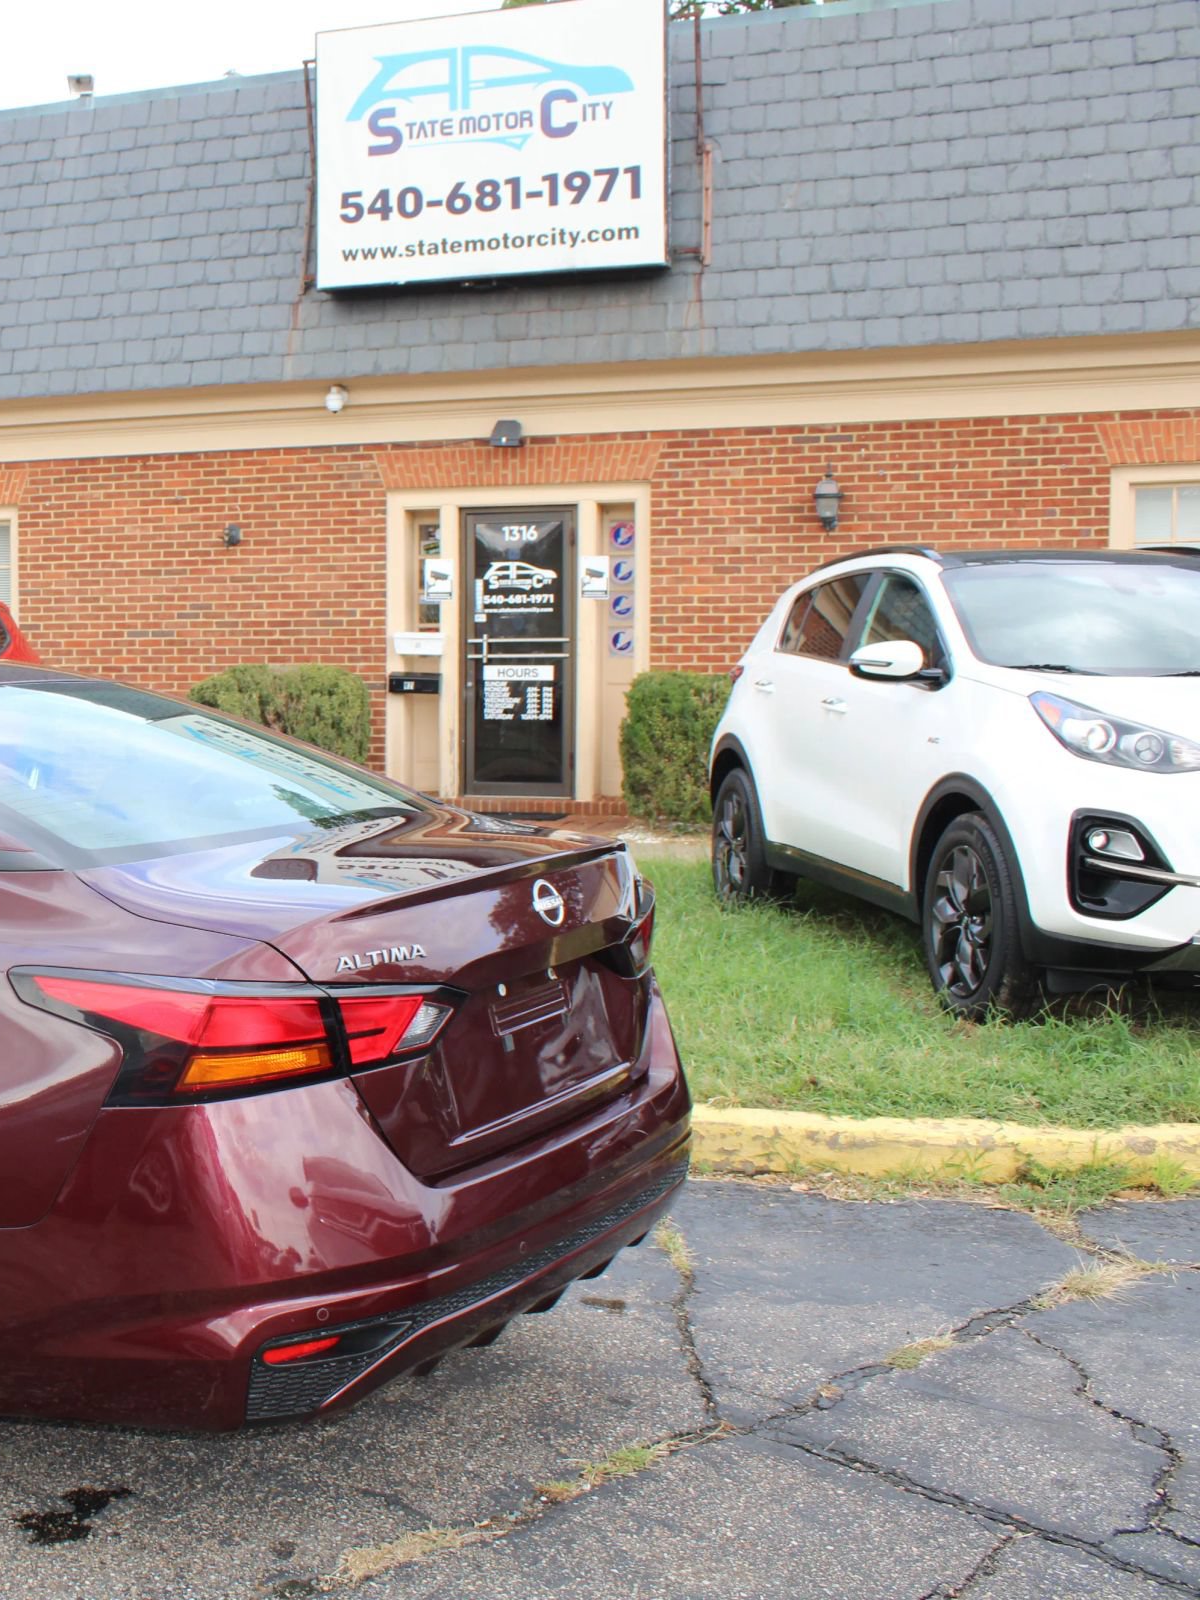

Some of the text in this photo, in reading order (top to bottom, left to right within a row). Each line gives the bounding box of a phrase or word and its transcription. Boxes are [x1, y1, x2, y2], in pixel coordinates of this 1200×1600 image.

[368, 88, 614, 157] STATE MOTOR CITY
[339, 165, 641, 224] 540-681-1971
[341, 226, 640, 262] www.statemotorcity.com
[501, 525, 538, 541] 1316
[483, 593, 554, 605] 540-681-1971
[497, 668, 538, 678] HOURS
[336, 944, 428, 973] ALTIMA
